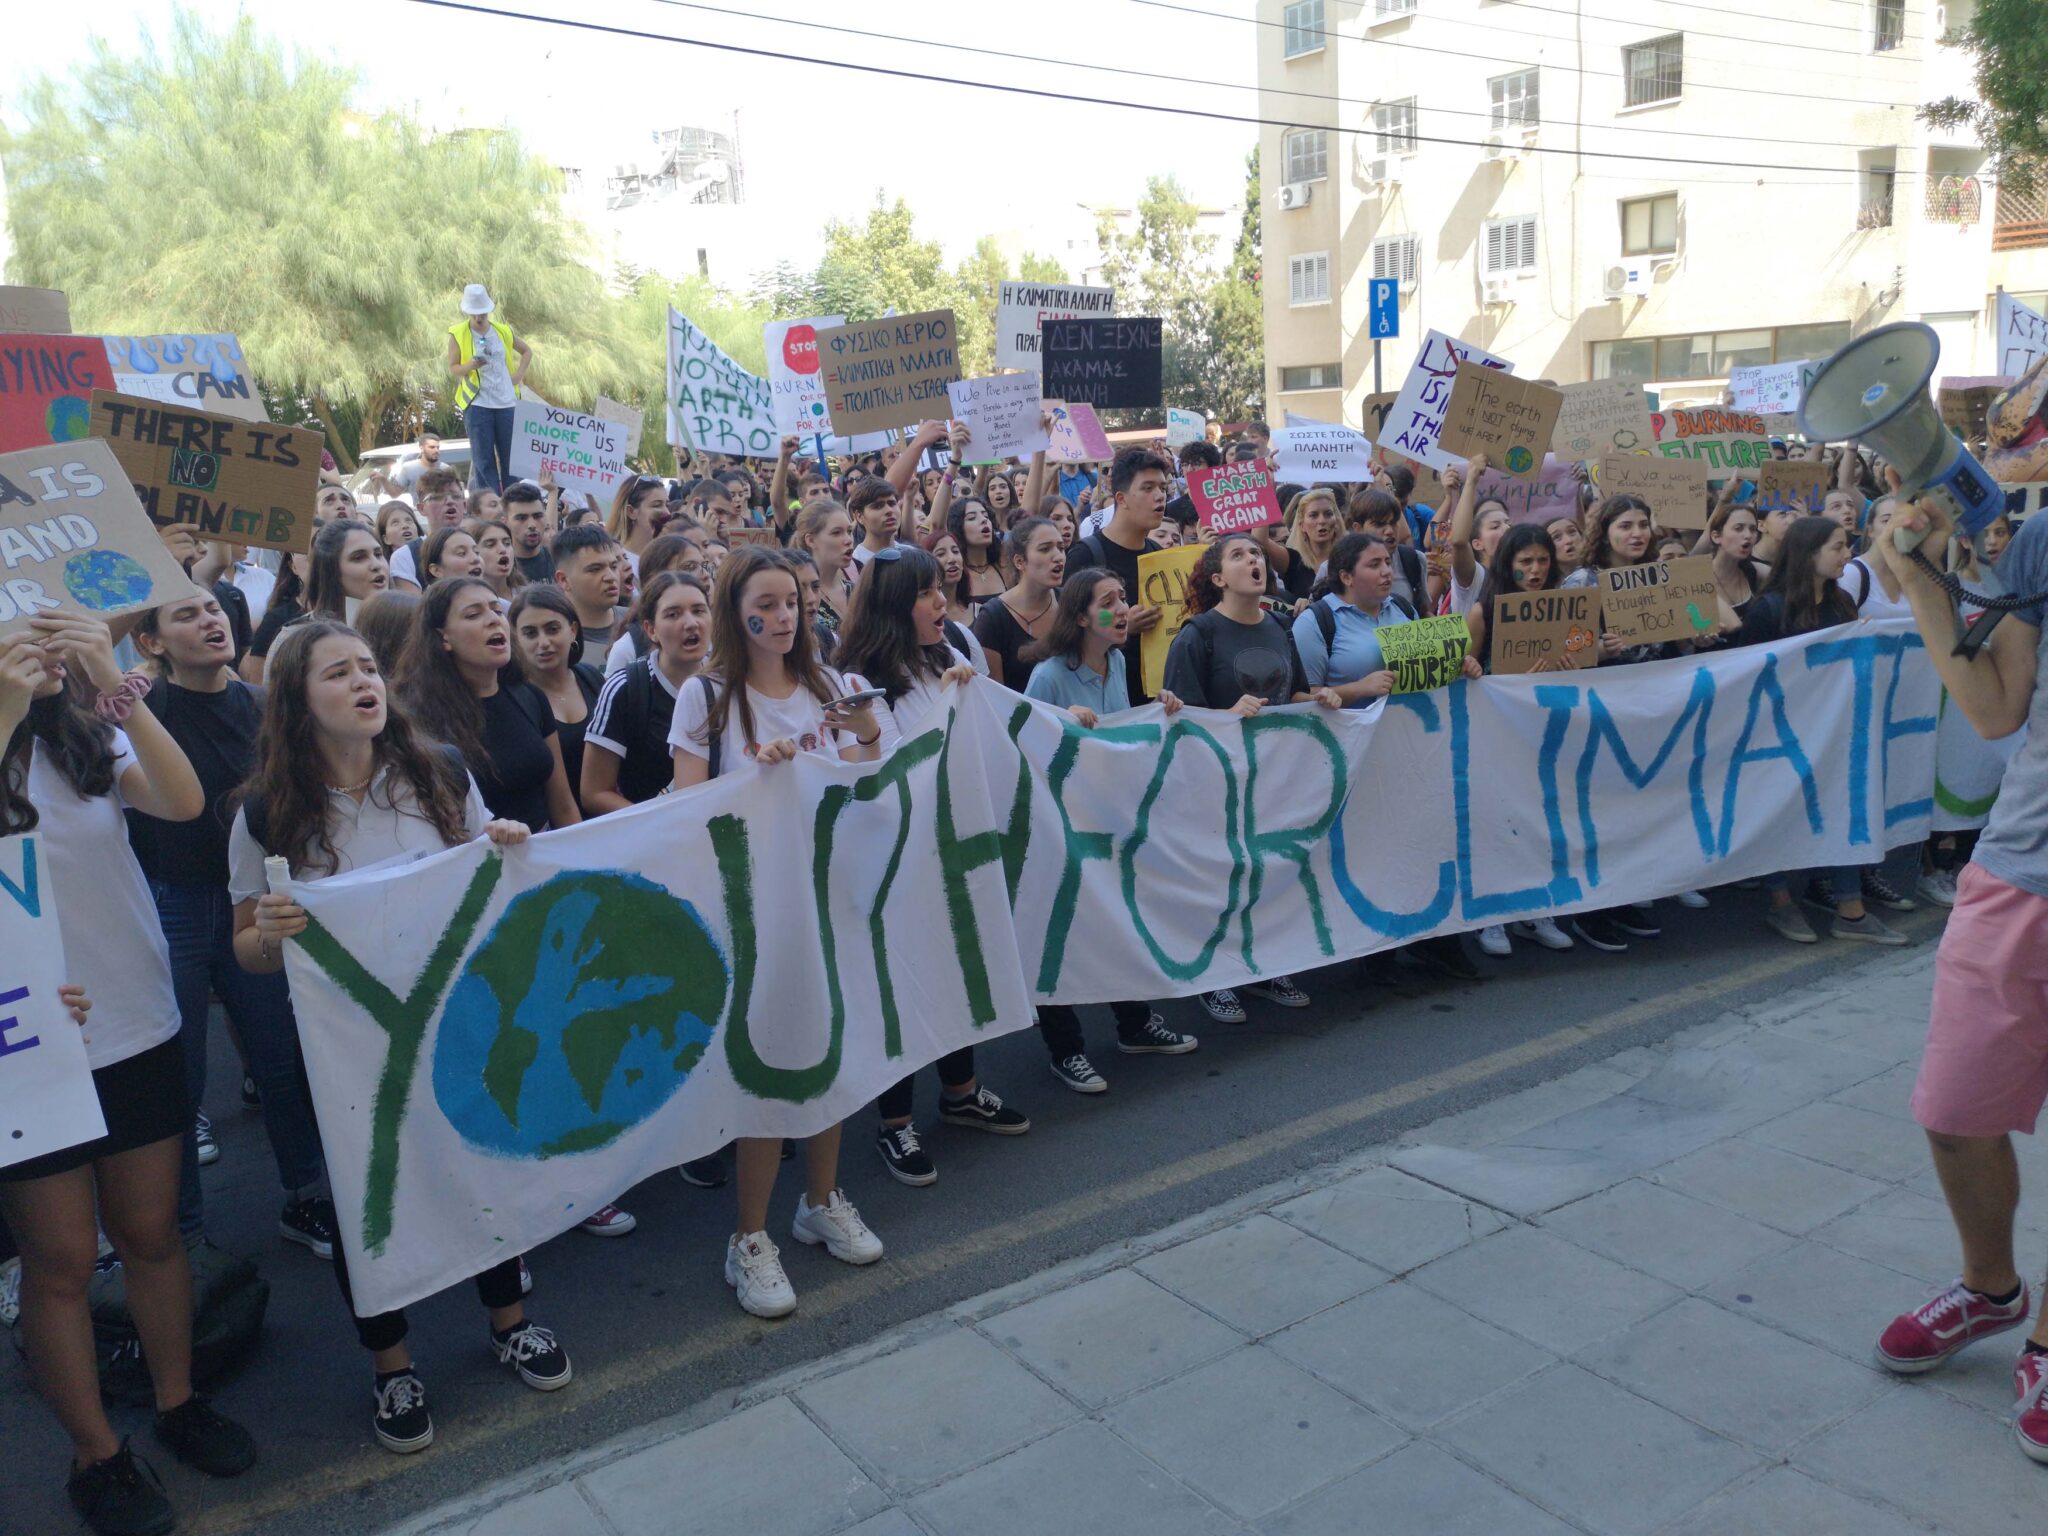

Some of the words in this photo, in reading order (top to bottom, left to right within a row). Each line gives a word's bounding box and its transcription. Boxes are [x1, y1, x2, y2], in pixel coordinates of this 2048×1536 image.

[1003, 287, 1012, 305] Η
[1016, 287, 1069, 309] ΚΛΙΜΑΤΙΚΗ
[1069, 292, 1114, 312] ΑΛΛΑΓΗ
[1377, 283, 1390, 308] P
[789, 340, 817, 355] STOP
[830, 329, 890, 355] ΦΥΣΙΚΟ
[895, 320, 946, 346] ΑΕΡΙΟ
[1015, 333, 1043, 352] ΠΡΑΓ
[1050, 324, 1093, 351] ΔΕΝ
[900, 349, 953, 372] ΑΛΛΑΓΗ
[1050, 359, 1128, 379] ΑΚΑΜΑΣ
[172, 371, 250, 400] CAN
[1737, 370, 1762, 381] STOP
[1739, 388, 1755, 396] THE
[1757, 380, 1800, 395] EARTH
[1752, 371, 1793, 387] DENYING
[957, 385, 980, 403] We
[1420, 378, 1446, 404] IS
[1470, 376, 1499, 407] The
[1505, 400, 1542, 423] earth
[1758, 394, 1769, 403] IS
[577, 416, 605, 434] CAN
[1481, 411, 1506, 425] NOT
[1561, 411, 1586, 423] FOR
[1614, 414, 1641, 425] HAVE
[1672, 409, 1766, 439] BURNING
[102, 402, 234, 457] THERE
[245, 431, 300, 468] IS
[524, 420, 580, 444] IGNORE
[595, 436, 615, 453] US
[1289, 430, 1328, 440] ΣΩΣΤΕ
[1330, 430, 1356, 440] ΤΟΝ
[1460, 425, 1474, 435] WE
[1294, 442, 1354, 453] ΠΛΑΝΗΤΗ
[1394, 430, 1429, 456] AIR
[172, 446, 218, 487] NO
[530, 439, 559, 456] BUT
[566, 447, 593, 466] YOU
[599, 456, 624, 475] WILL
[1213, 460, 1256, 479] MAKE
[1311, 459, 1338, 470] ΜΑΣ
[28, 462, 105, 501] IS
[540, 457, 597, 480] REGRET
[600, 472, 615, 486] IT
[1202, 471, 1268, 499] EARTH
[1213, 490, 1258, 511] GREAT
[265, 506, 296, 543] B
[1210, 505, 1268, 533] AGAIN
[1609, 563, 1669, 592] DINO'S
[1501, 595, 1587, 624] LOSING
[1607, 591, 1657, 612] thought
[1664, 586, 1688, 600] THEY
[1691, 582, 1715, 595] HAD
[1637, 608, 1675, 632] TOO!
[1442, 637, 1468, 662] MY
[1502, 637, 1552, 660] nemo
[1387, 656, 1449, 695] FUTURE
[1035, 712, 1349, 997] FOR
[1330, 632, 1938, 940] CLIMATE
